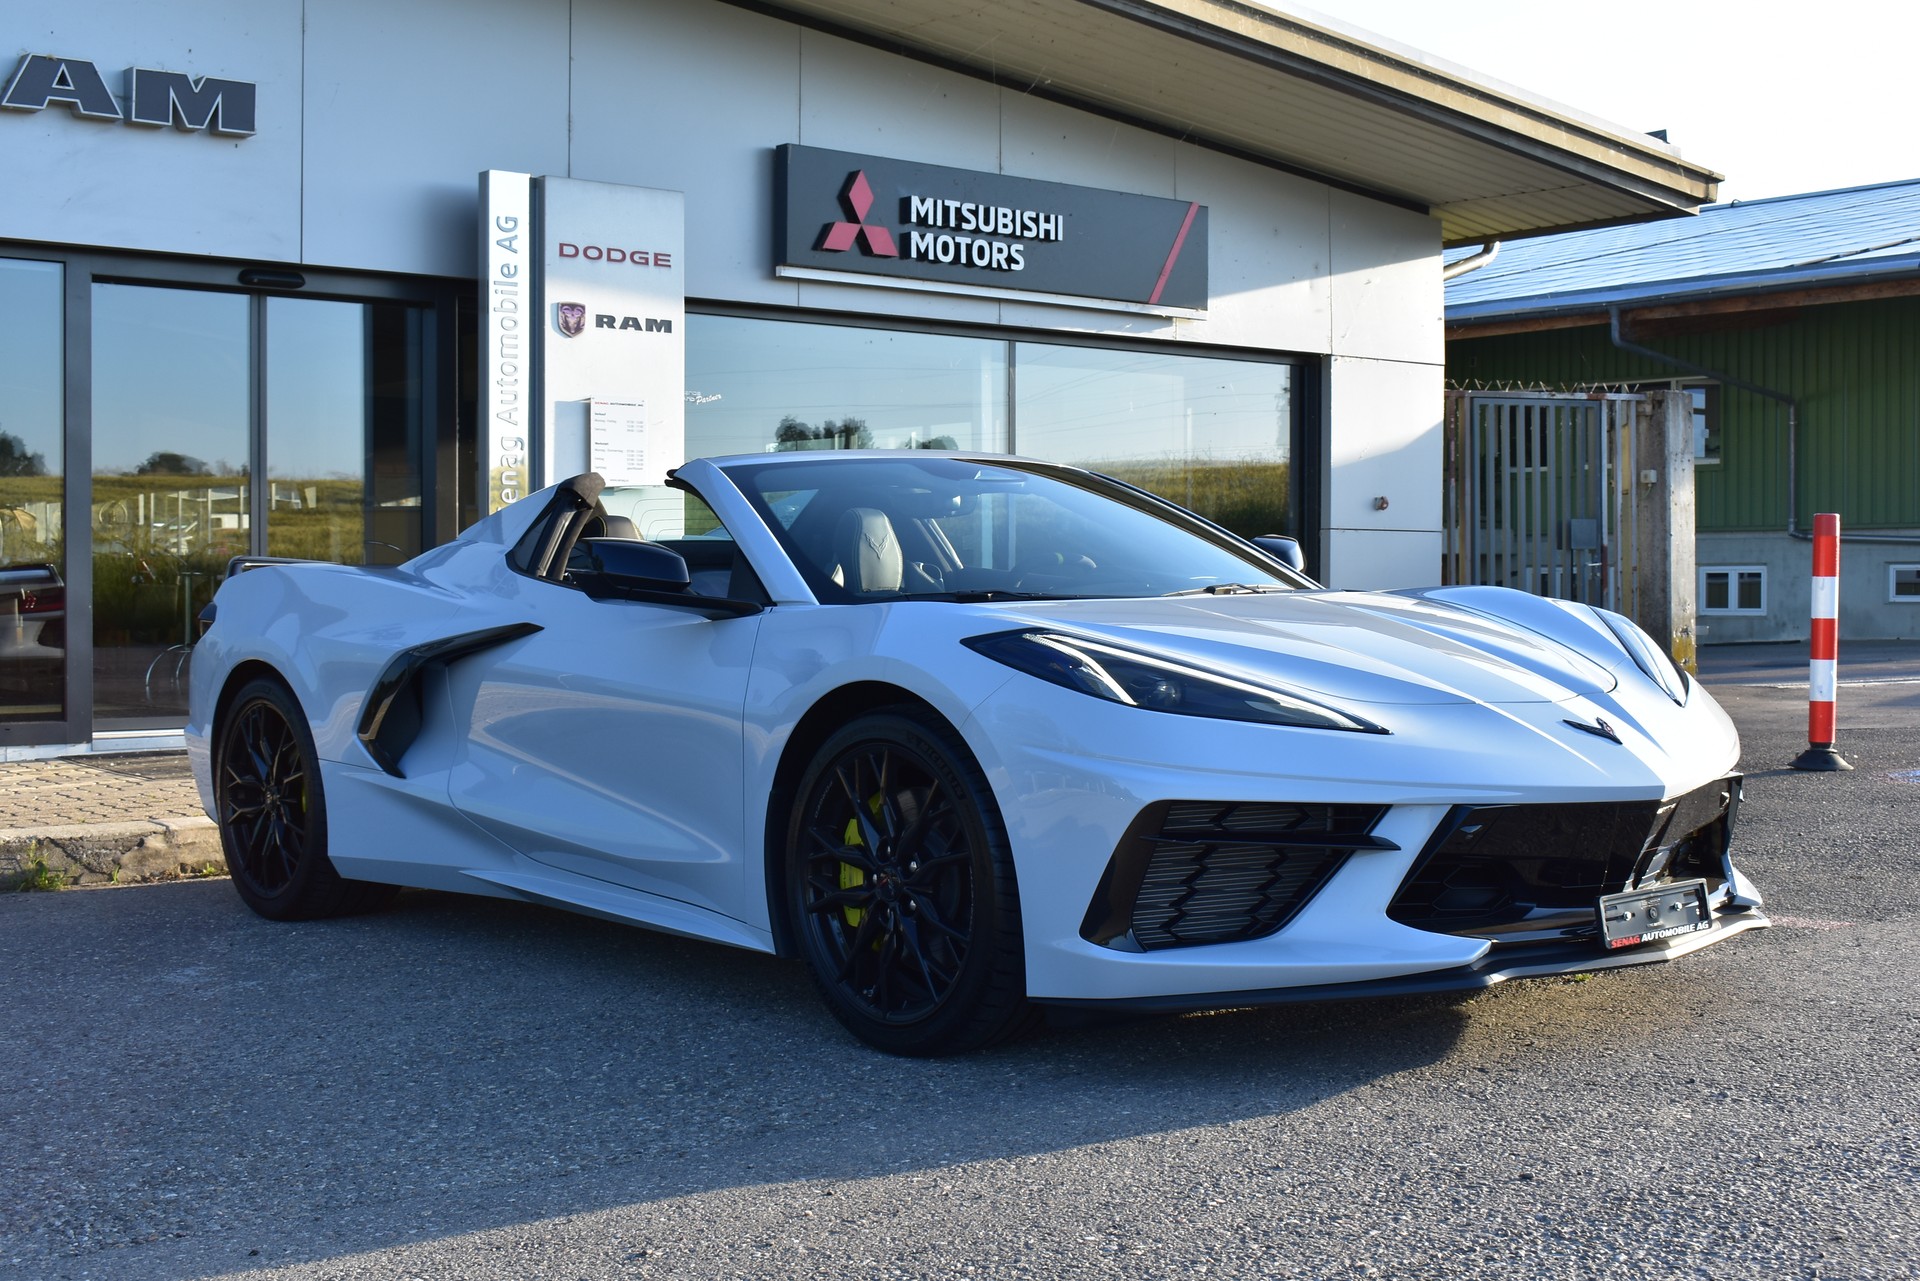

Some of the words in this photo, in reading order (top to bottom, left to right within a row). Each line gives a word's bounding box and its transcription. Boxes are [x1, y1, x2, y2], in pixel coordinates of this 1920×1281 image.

[496, 216, 518, 254] AG
[910, 195, 1064, 242] MITSUBISHI
[558, 242, 672, 269] DODGE
[910, 231, 1026, 272] MOTORS
[595, 313, 673, 334] RAM
[493, 263, 518, 426] Automobile
[497, 436, 524, 511] enag
[1611, 935, 1641, 949] SENAG
[1641, 923, 1696, 943] AUTOMOBILE
[1697, 920, 1709, 933] AG
